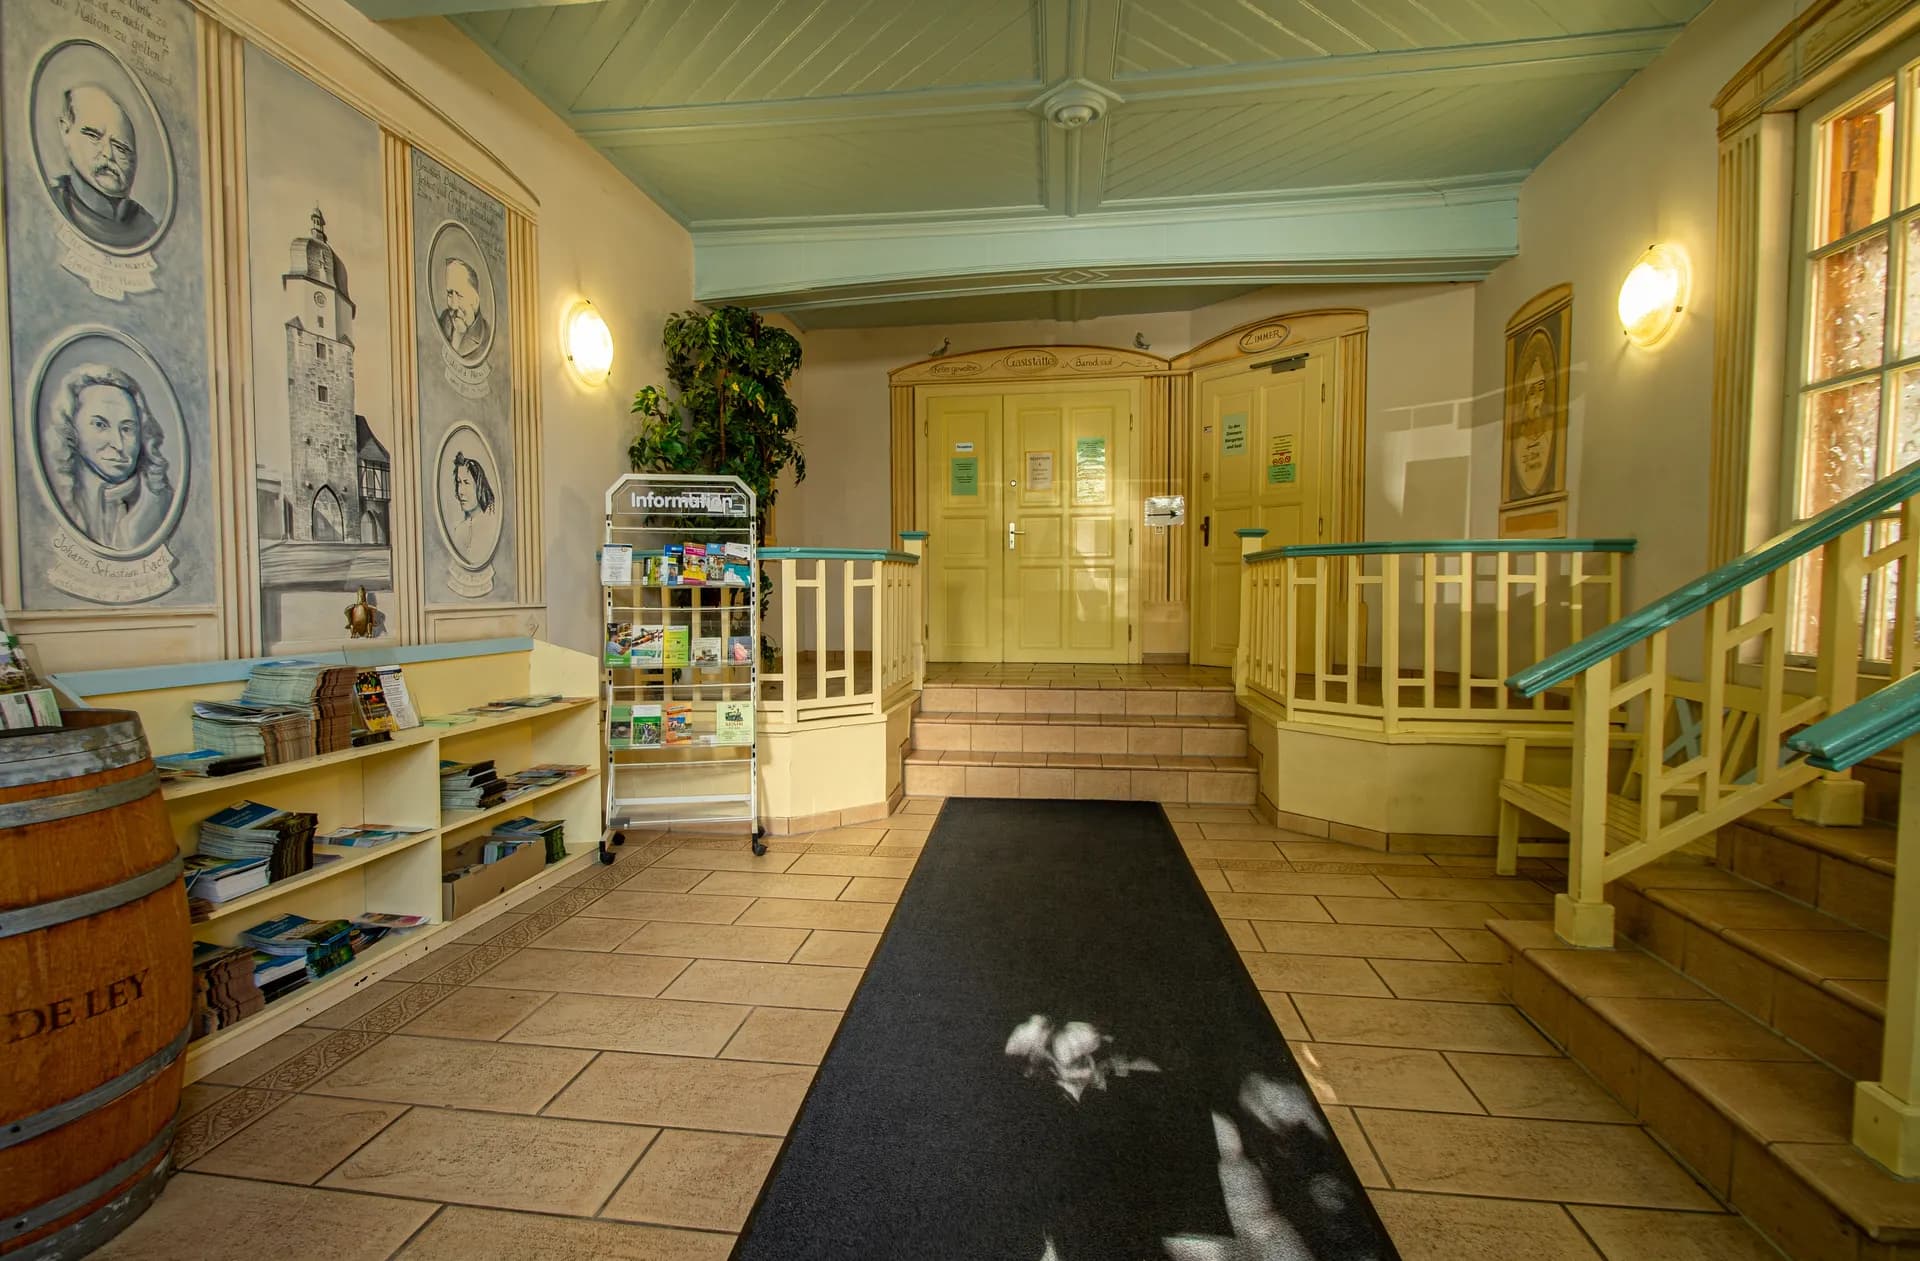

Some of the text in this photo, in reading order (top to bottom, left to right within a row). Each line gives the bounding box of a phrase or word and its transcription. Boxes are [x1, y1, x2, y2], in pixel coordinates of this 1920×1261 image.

[113, 30, 128, 44] zu
[1244, 328, 1283, 346] ZIMMER
[1005, 356, 1055, 368] Gaststätte
[631, 492, 733, 508] Information
[53, 533, 170, 578] Johann Sebastian Bach
[3, 967, 150, 1045] DE LEY
